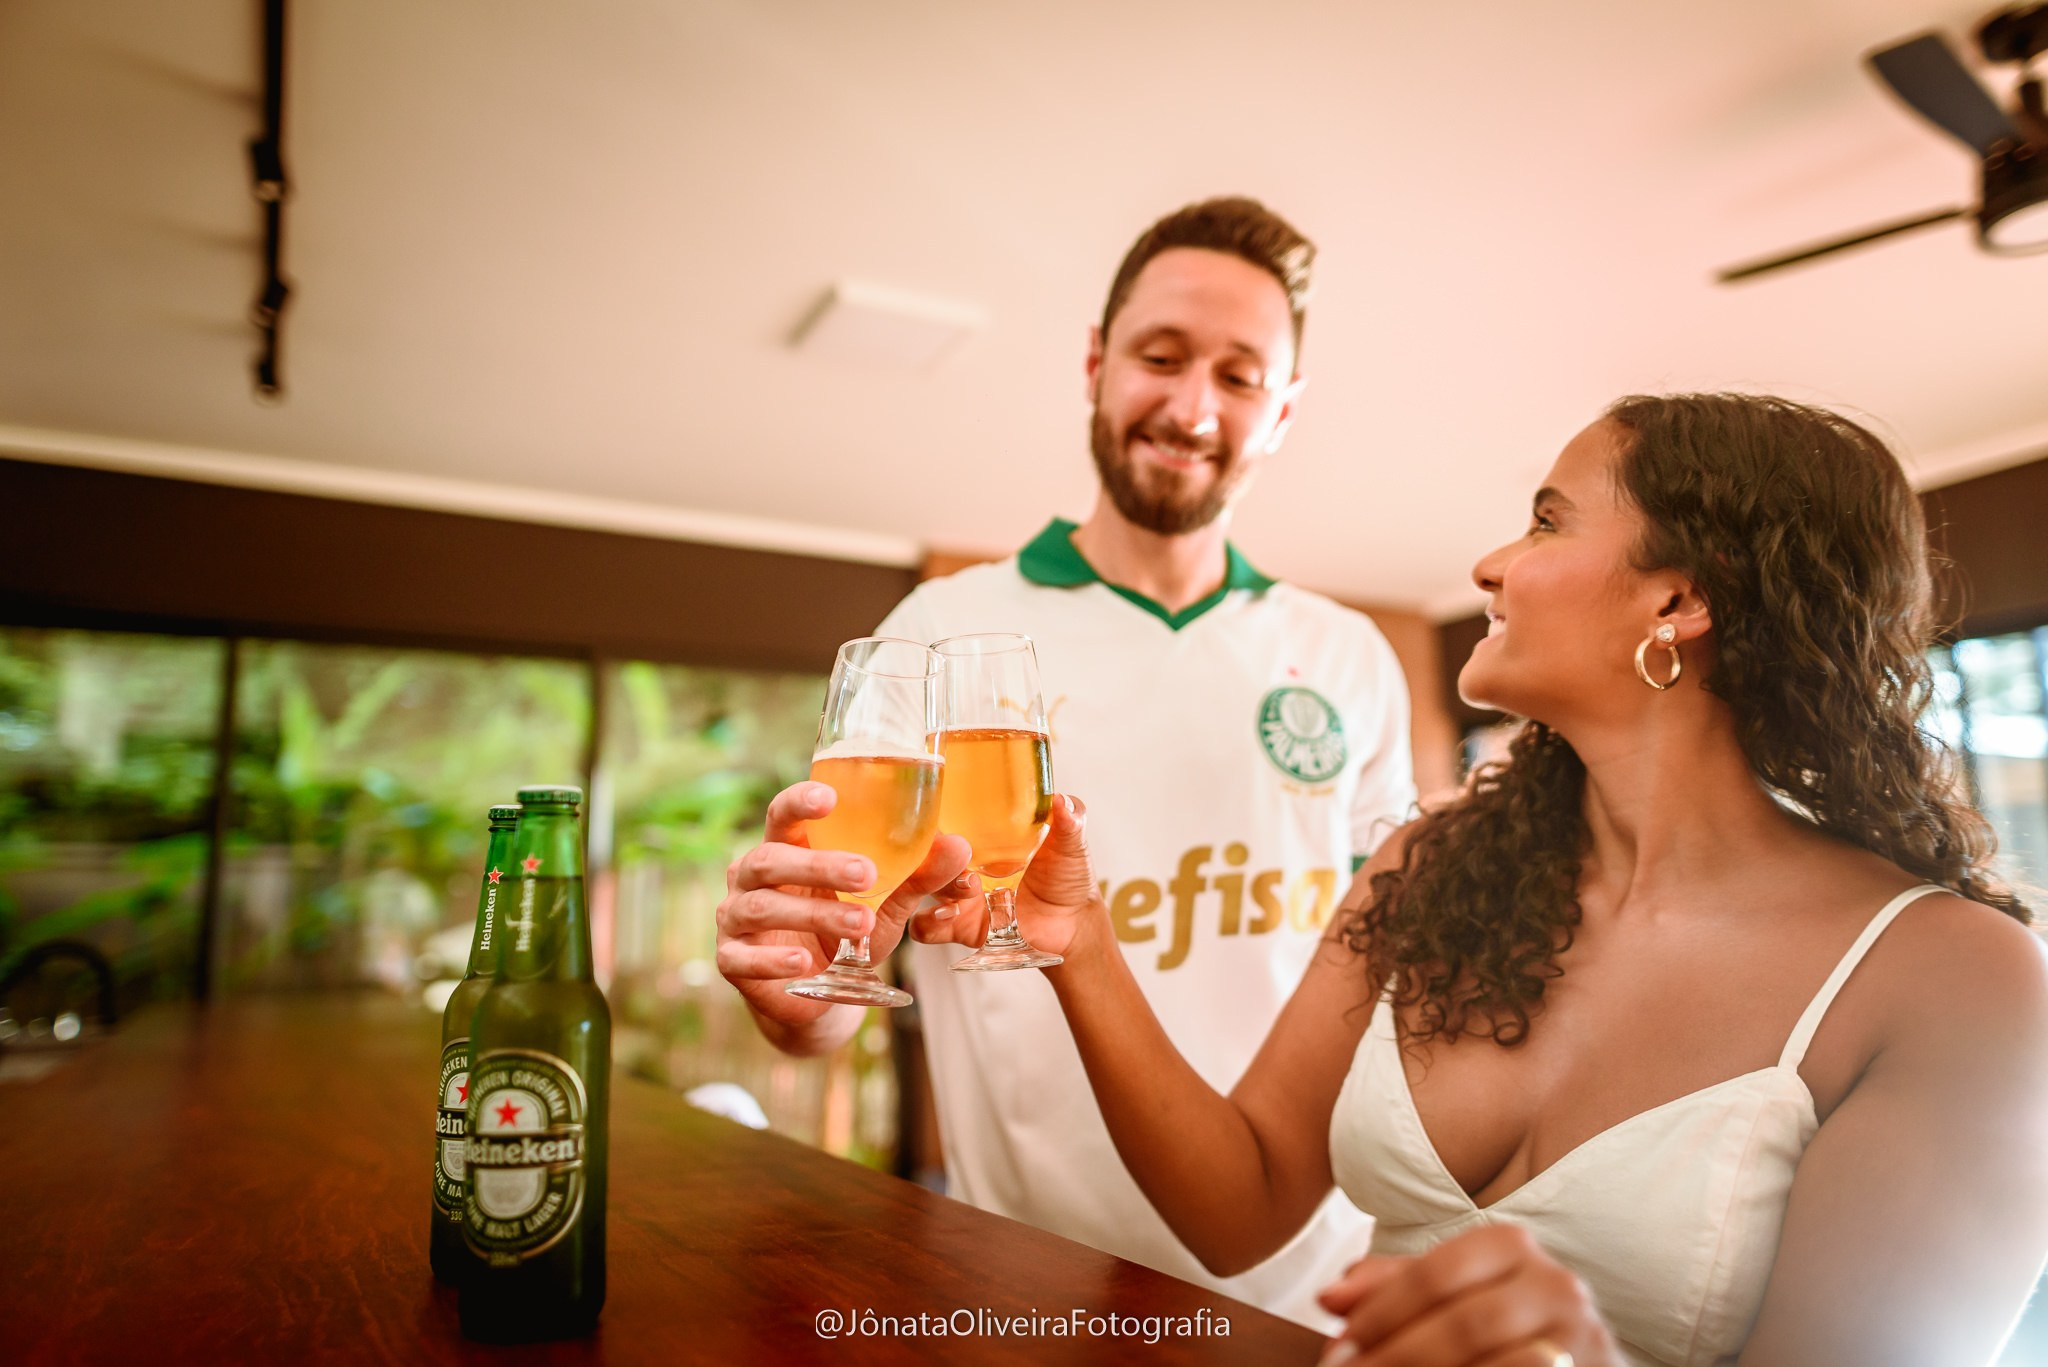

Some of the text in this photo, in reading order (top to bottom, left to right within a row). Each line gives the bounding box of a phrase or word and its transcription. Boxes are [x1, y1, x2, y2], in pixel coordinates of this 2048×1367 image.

[480, 888, 497, 951] Heineken
[439, 1056, 468, 1097] HEINEKEN
[435, 1161, 447, 1190] PURE
[450, 1210, 463, 1221] 330
[523, 1191, 563, 1233] LAGER
